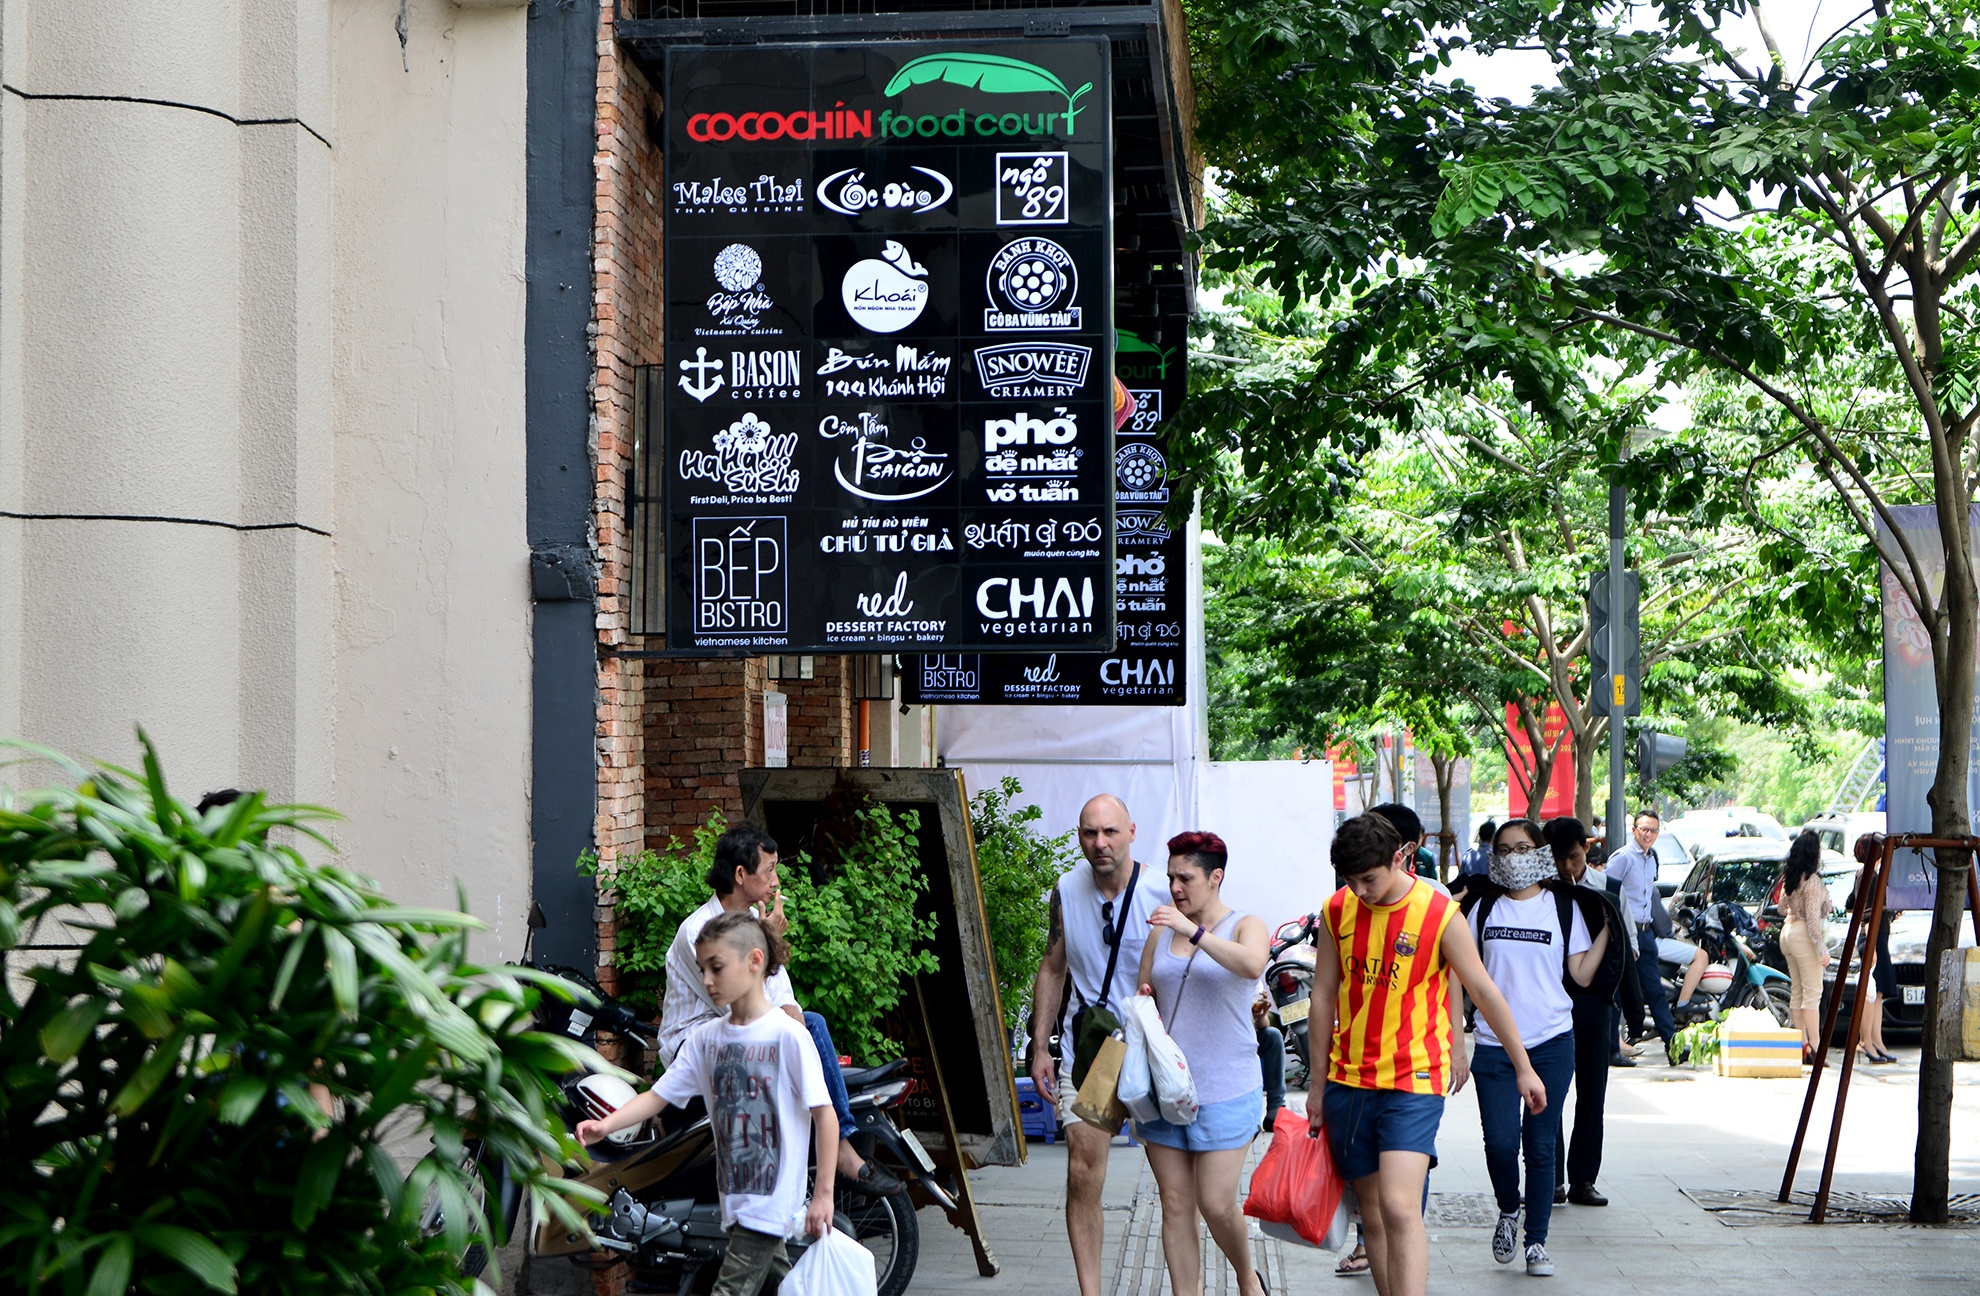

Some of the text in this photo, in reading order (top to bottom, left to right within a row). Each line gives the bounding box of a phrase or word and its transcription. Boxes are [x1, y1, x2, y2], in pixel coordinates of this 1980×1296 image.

[687, 100, 1087, 142] COCOCHÍN food court
[673, 174, 804, 205] Malee Thai
[840, 171, 932, 210] Ốc Đào
[1022, 185, 1064, 218] 89
[855, 279, 916, 302] Khoái
[740, 291, 774, 315] Nhà
[694, 327, 784, 336] Vietnamese cuisine
[731, 350, 800, 387] BASON
[731, 388, 801, 399] coffee
[825, 374, 946, 398] 144 Khánh Hội
[990, 385, 1076, 398] CREAMERY
[984, 406, 1078, 452] phở
[1131, 411, 1158, 431] 89
[866, 462, 944, 479] SAIGON
[690, 496, 710, 504] First
[731, 495, 754, 504] Price
[756, 495, 768, 504] be
[769, 494, 792, 503] Best!
[986, 483, 1017, 502] võ
[902, 516, 929, 528] VIÊN
[1062, 518, 1102, 542] ĐÓ
[701, 520, 779, 600] BẾP
[857, 570, 914, 618] red
[976, 577, 1094, 619] CHAI
[701, 601, 781, 628] BISTRO
[826, 620, 946, 632] DESSERT FACTORY
[826, 634, 839, 642] ice
[877, 634, 905, 643] bingsu
[916, 633, 944, 642] bakery
[980, 621, 1092, 637] vegetarian
[694, 636, 788, 646] vietnamese kitchen
[924, 670, 976, 688] BISTRO
[1024, 653, 1060, 683] red
[1100, 658, 1174, 685] CHAI
[1004, 684, 1081, 692] DESSERT FACTORY
[1102, 686, 1174, 697] vegetarian
[1346, 956, 1400, 980] QATAR
